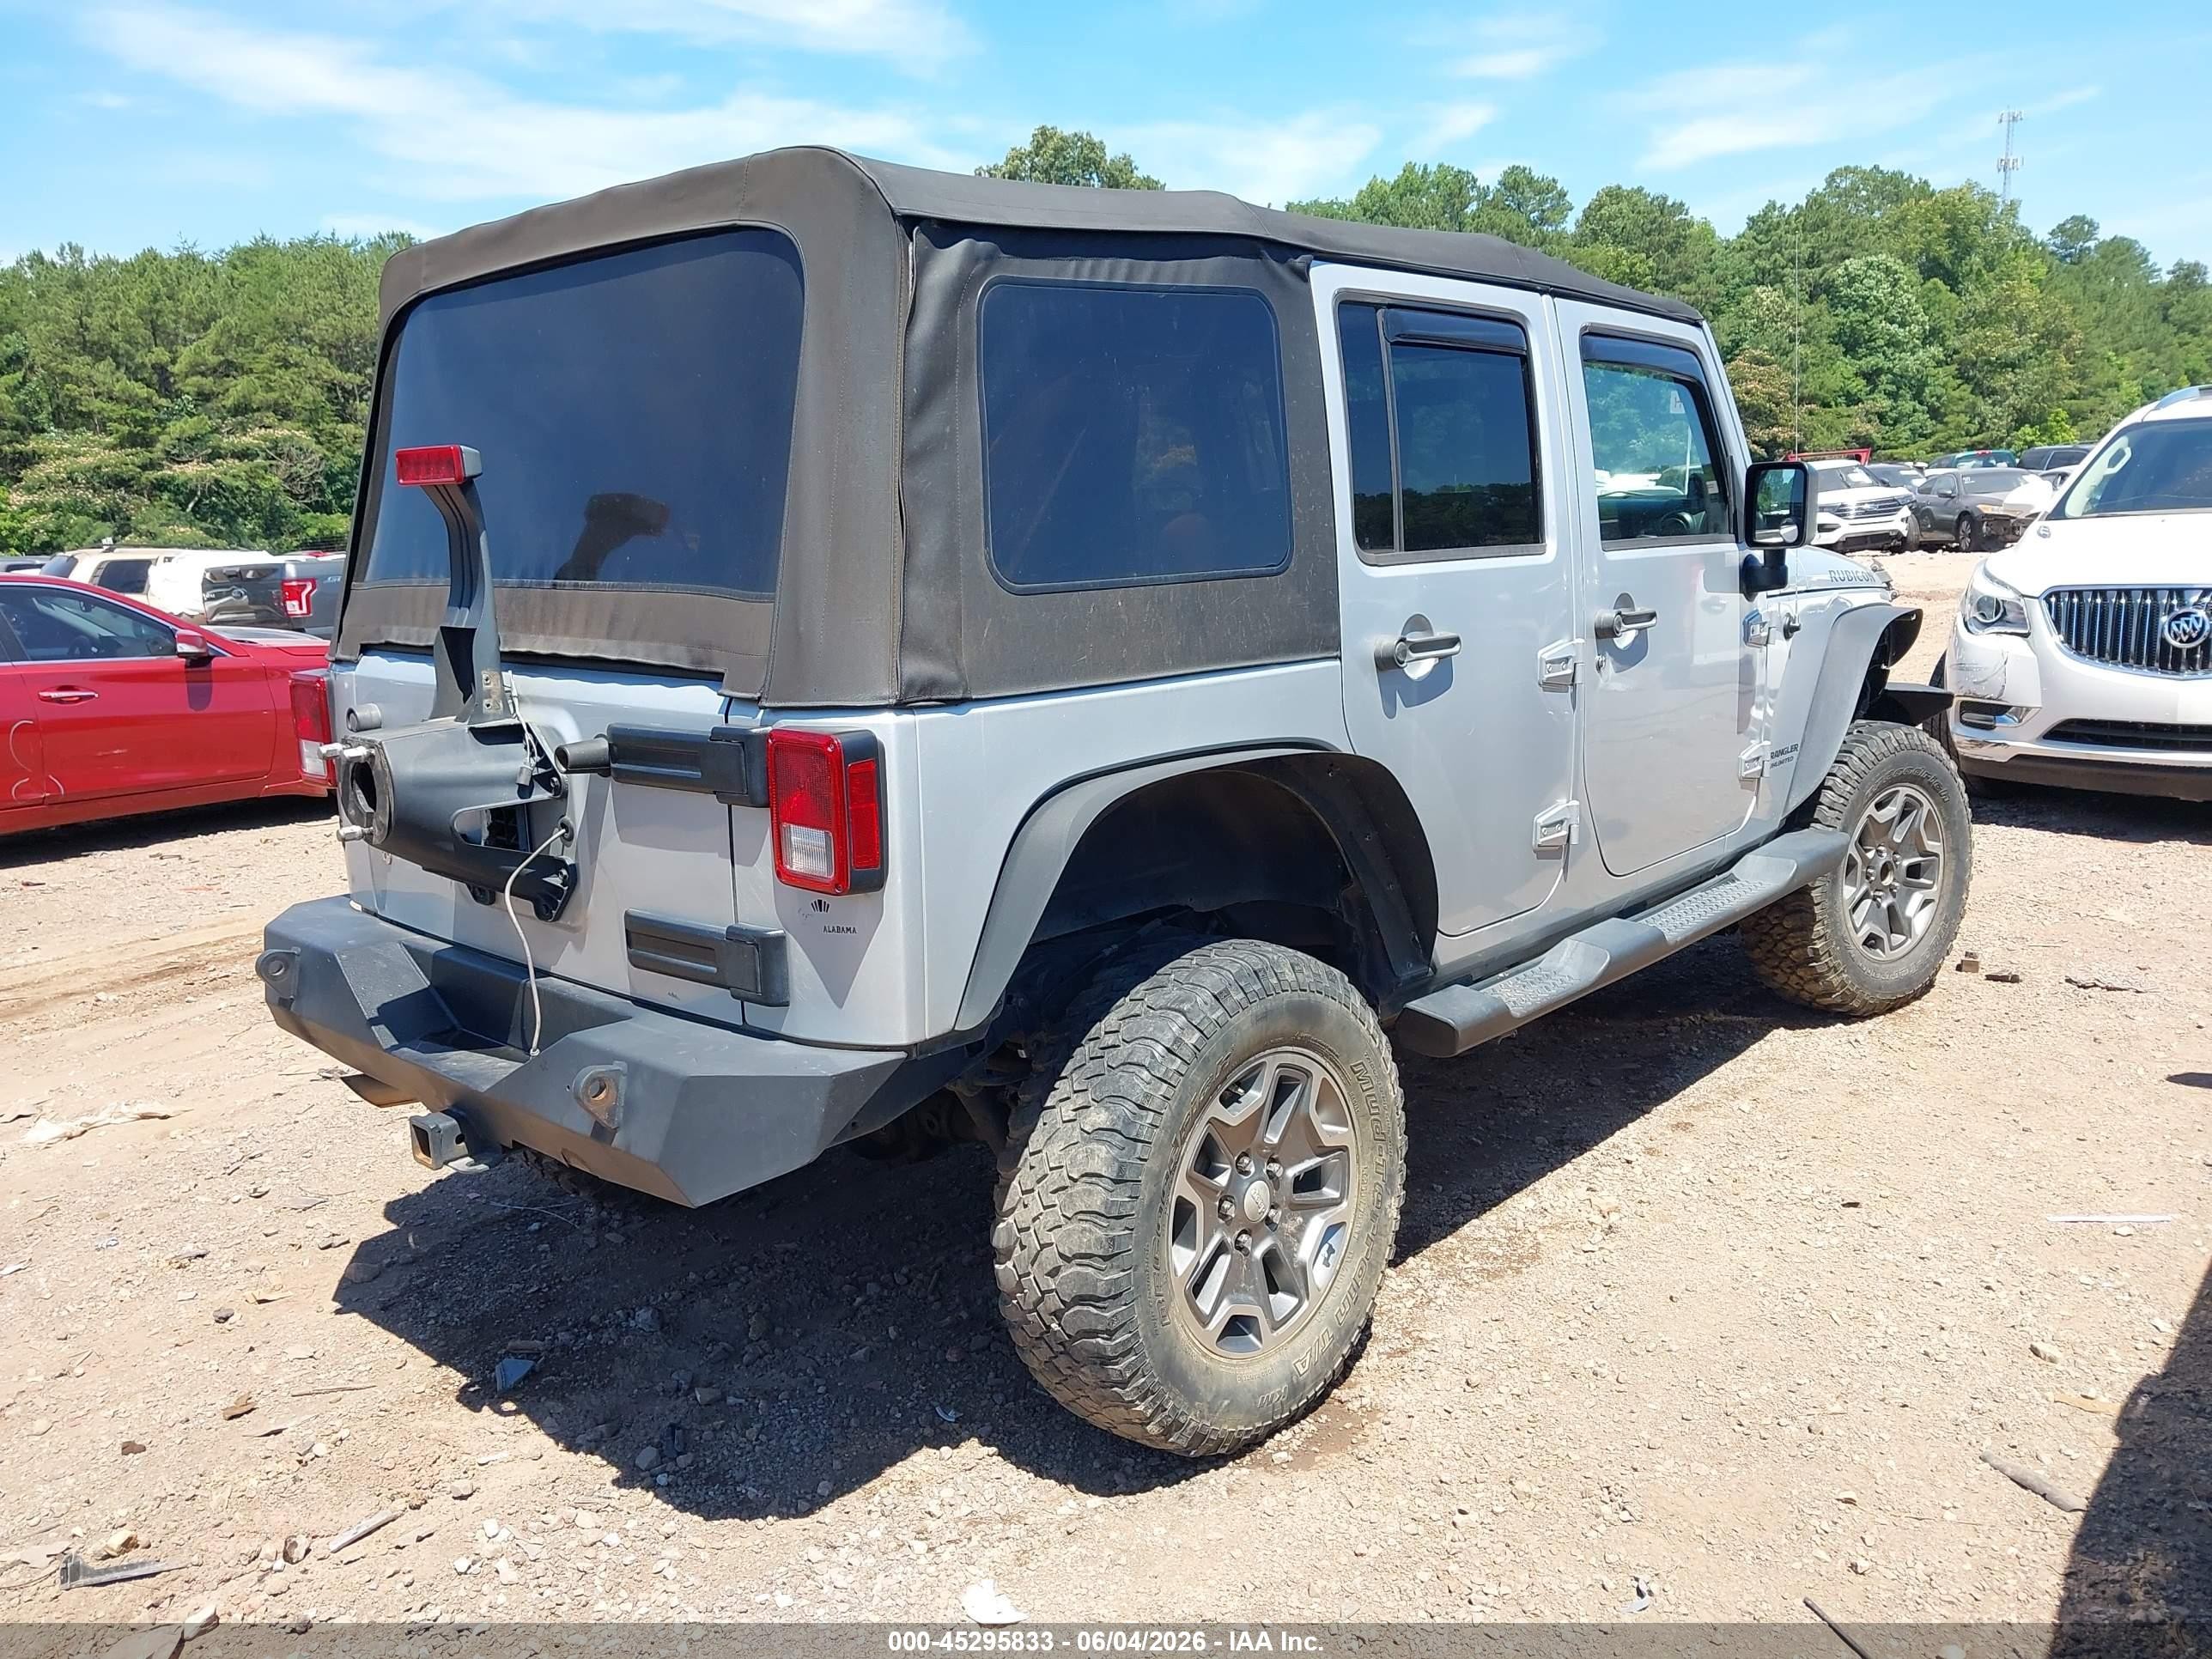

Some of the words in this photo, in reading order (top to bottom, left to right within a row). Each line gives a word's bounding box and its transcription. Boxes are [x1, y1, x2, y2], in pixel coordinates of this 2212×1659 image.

[1828, 569, 1875, 582] RUBICON
[1770, 743, 1799, 759] RANGLER
[823, 925, 857, 934] ALABAMA
[1334, 1060, 1387, 1327] Mud-Terrain
[1292, 1328, 1334, 1377] T/A
